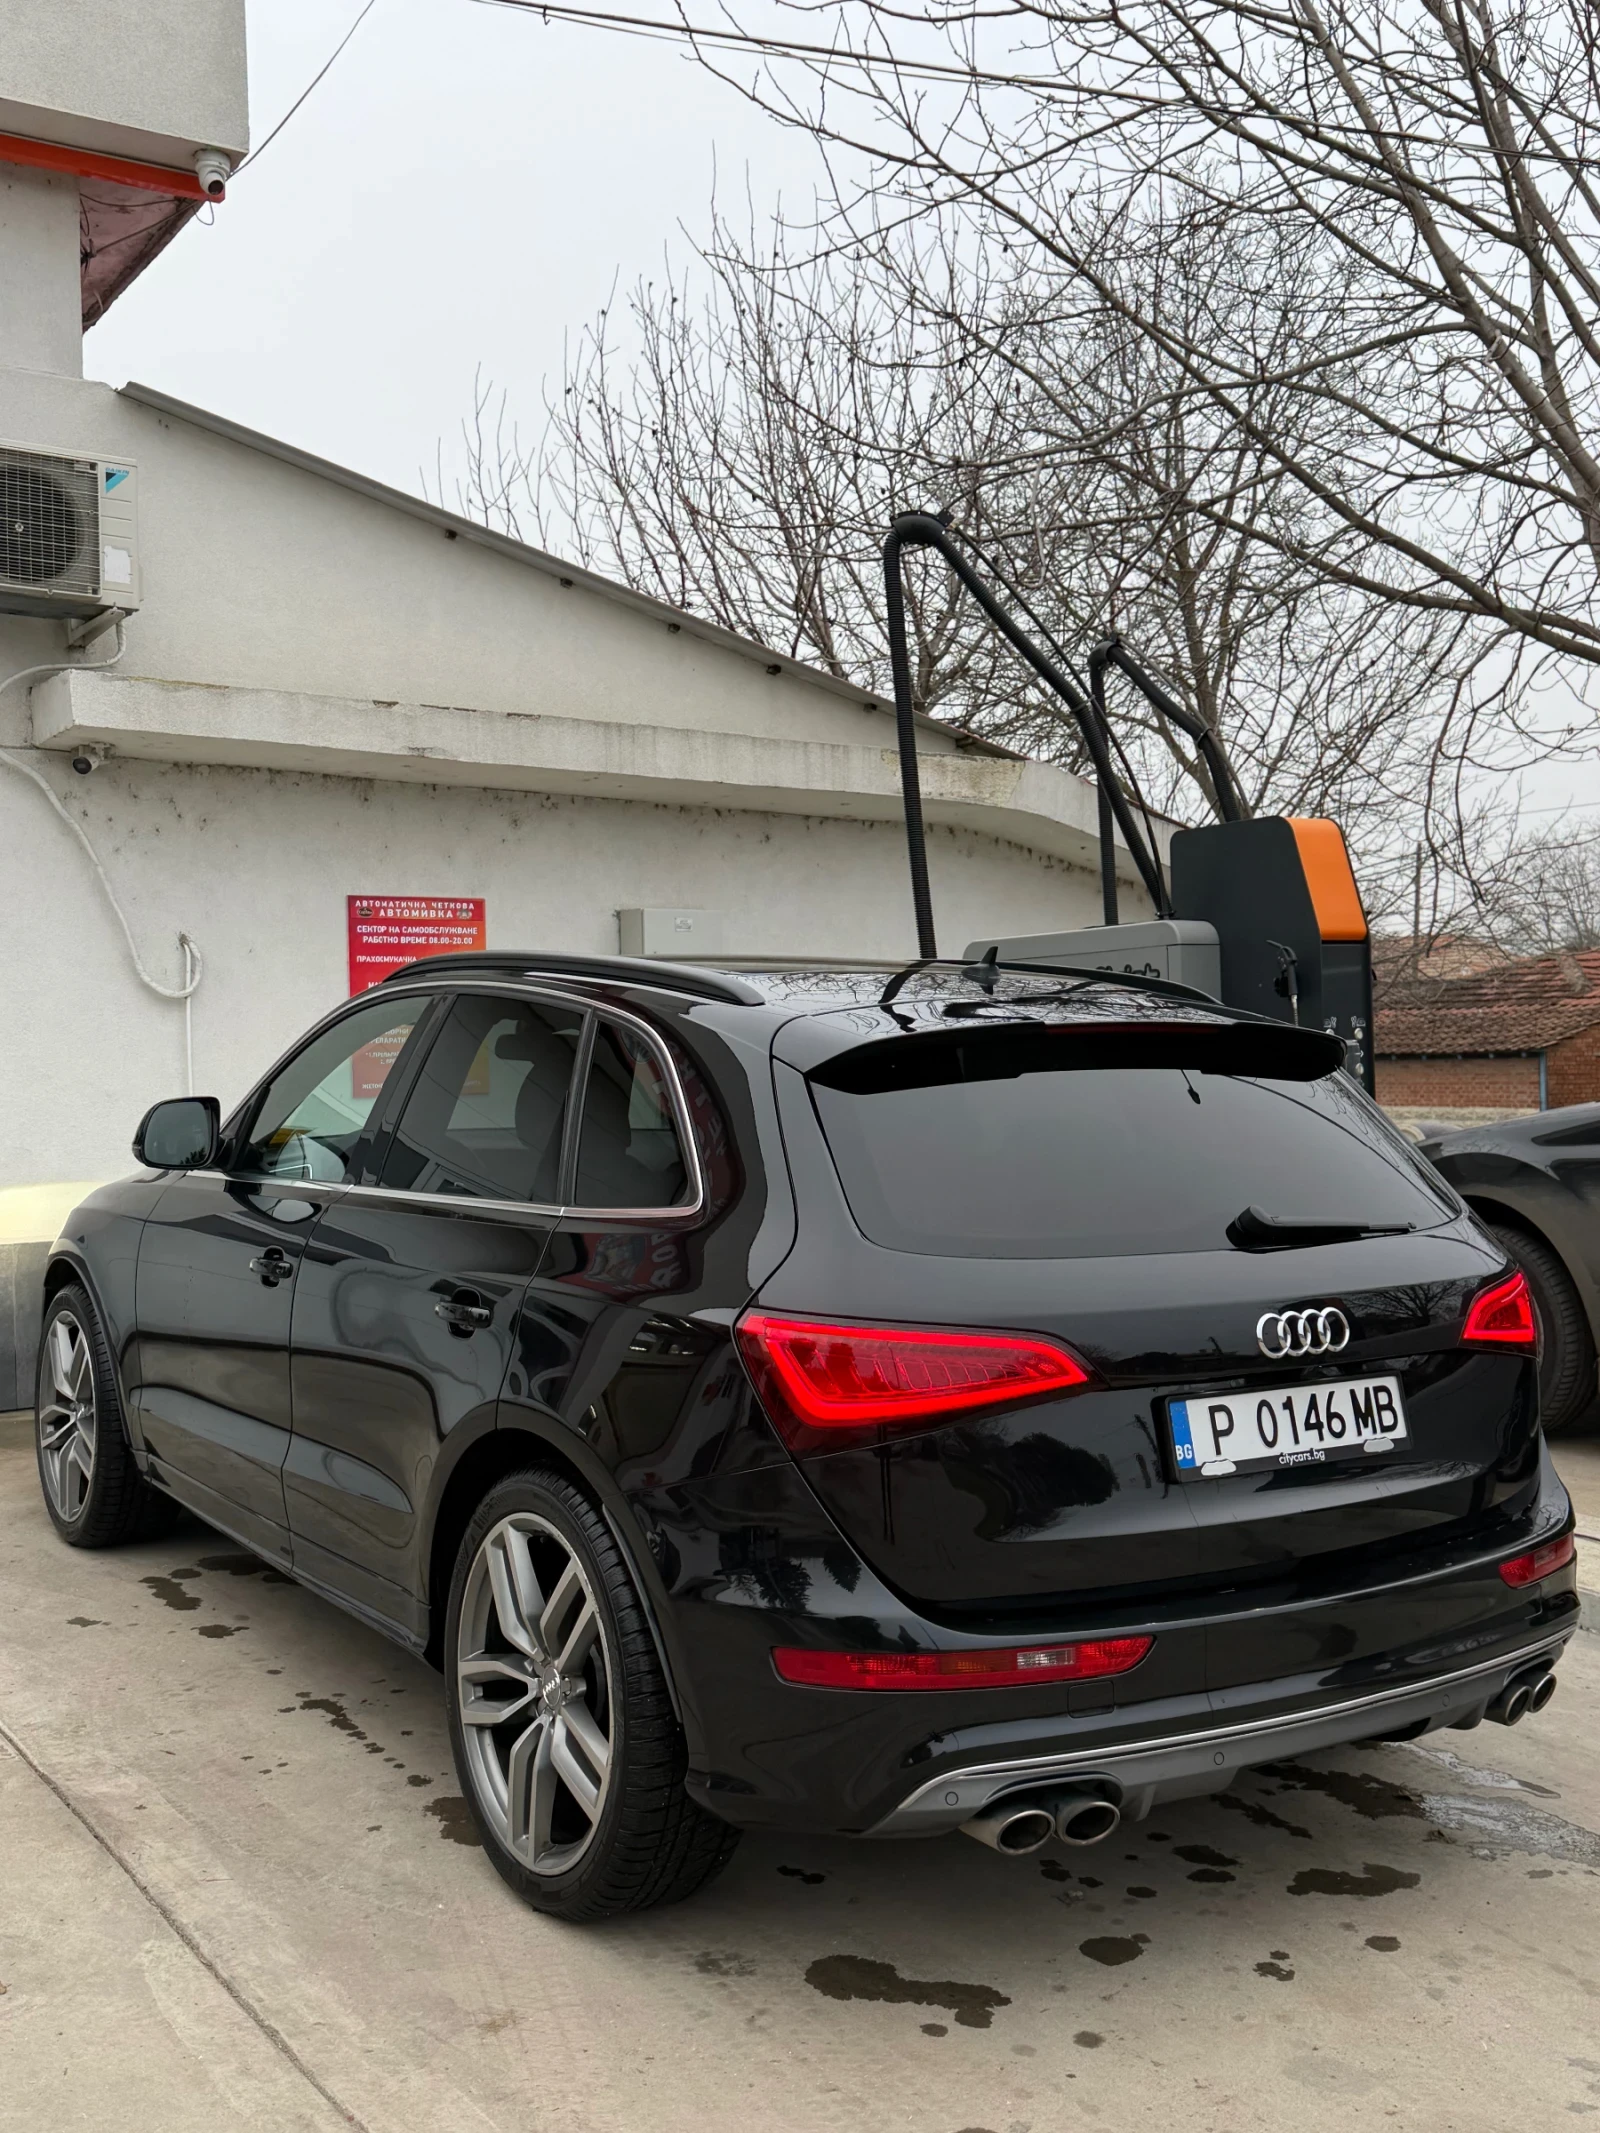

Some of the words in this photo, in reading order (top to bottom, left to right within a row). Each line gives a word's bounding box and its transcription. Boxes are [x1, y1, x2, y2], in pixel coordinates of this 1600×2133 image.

[356, 900, 426, 909] АВТОМАТИЧНА
[432, 902, 475, 910] ЧЕТКОВА
[379, 909, 453, 918] АВТОМИВКА
[357, 925, 387, 933] СЕКТОР
[389, 925, 400, 933] НА
[402, 926, 478, 934] САМООБСЛУЖВАНЕ
[363, 936, 398, 944] РАБОТНО
[401, 936, 427, 944] ВРЕМЕ
[429, 937, 473, 945] 08.00-20.00
[356, 955, 417, 963] ПРАХОСМУКАЧКА
[1208, 1404, 1234, 1456] P
[1256, 1390, 1347, 1449] 0146
[1349, 1385, 1399, 1437] MB
[1175, 1443, 1193, 1461] BG
[1278, 1448, 1325, 1466] citycars.bg
